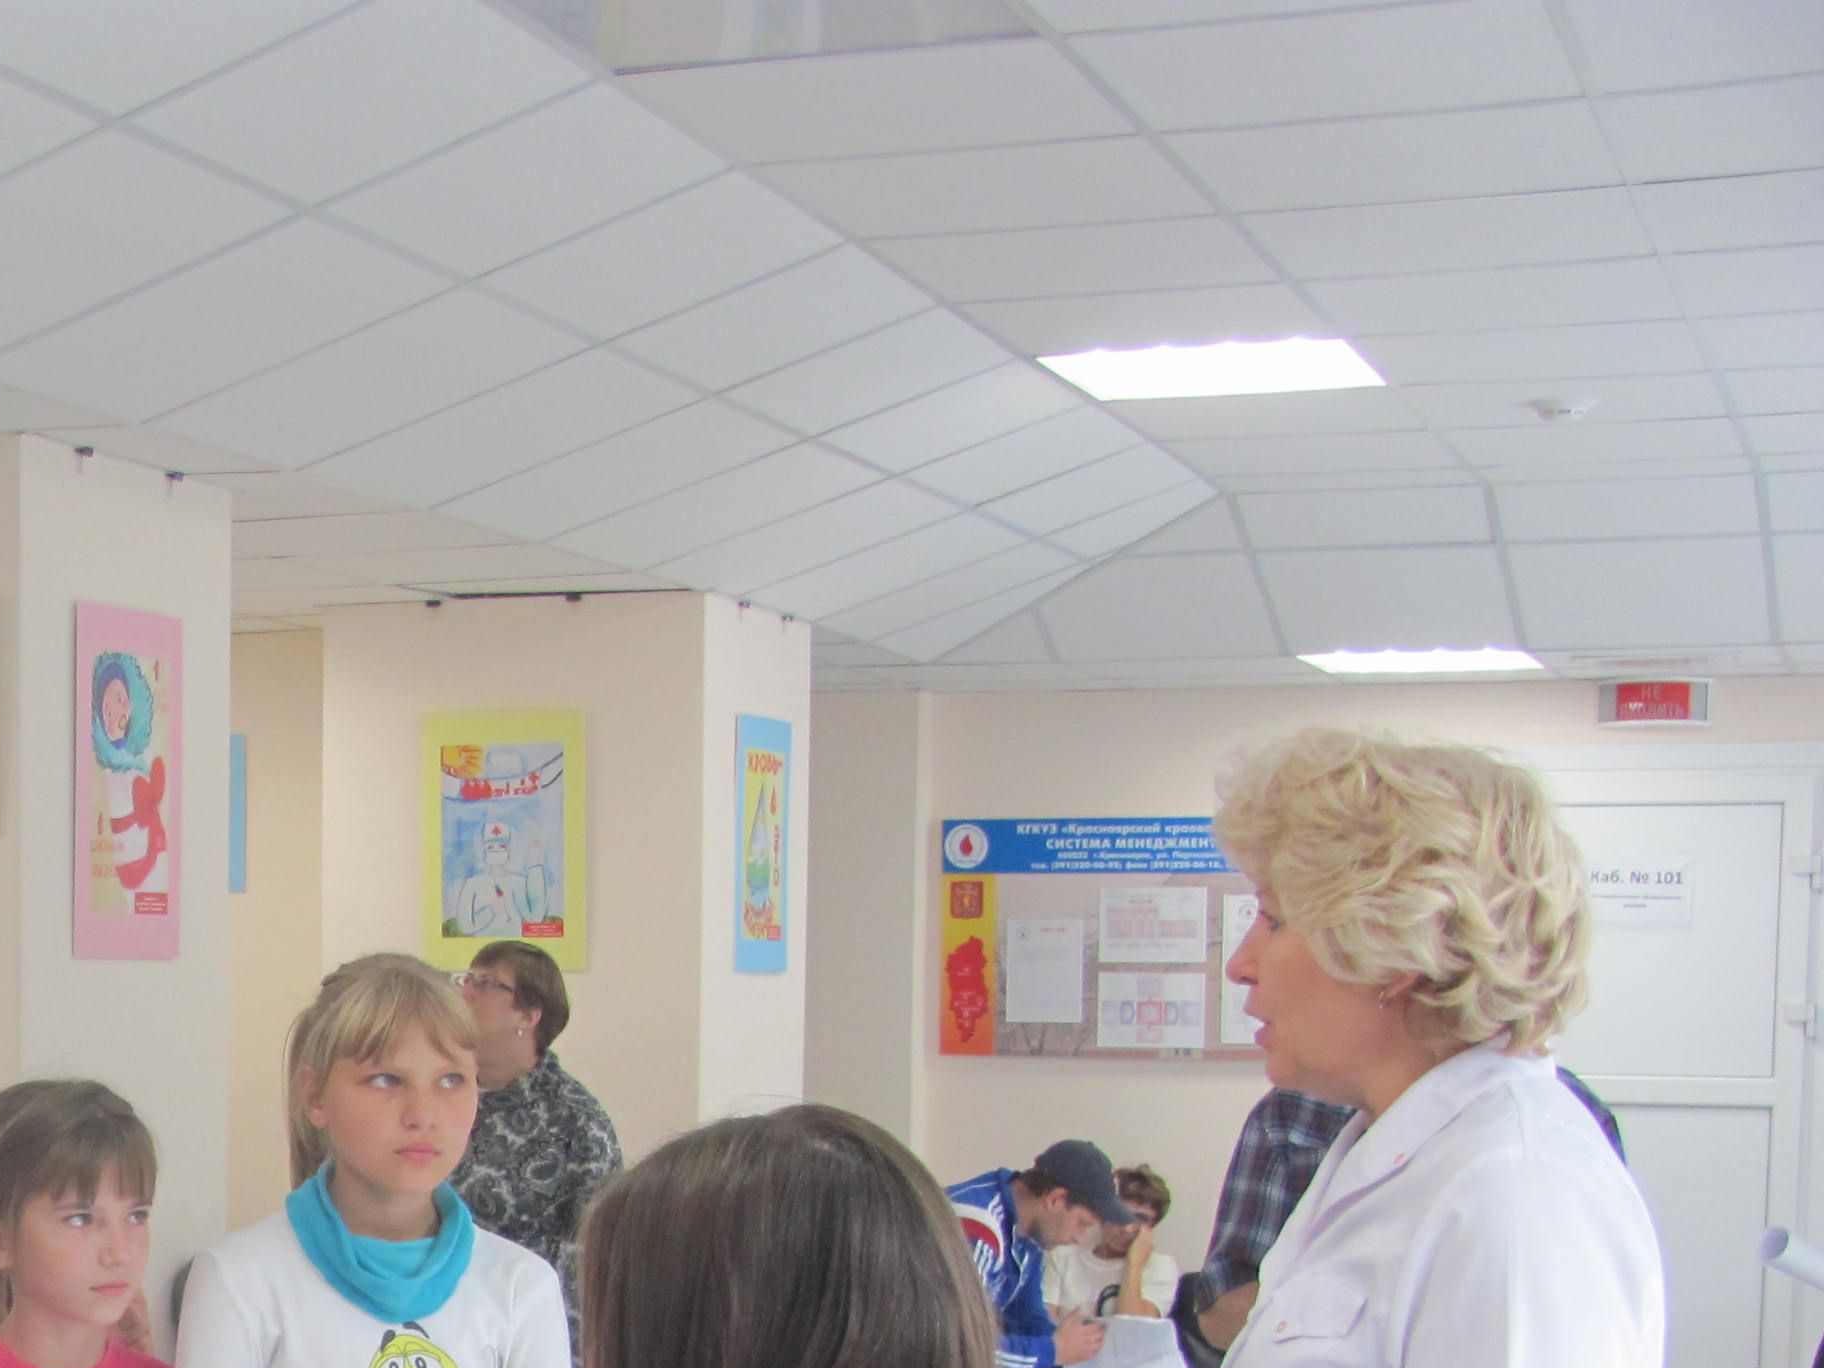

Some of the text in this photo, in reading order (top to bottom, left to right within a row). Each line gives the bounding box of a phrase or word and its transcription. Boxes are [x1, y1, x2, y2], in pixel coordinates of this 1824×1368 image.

[1046, 837, 1216, 850] СИСТЕМА МЕНЕДЖМЕНТ
[1590, 870, 1683, 885] Каб. № 101
